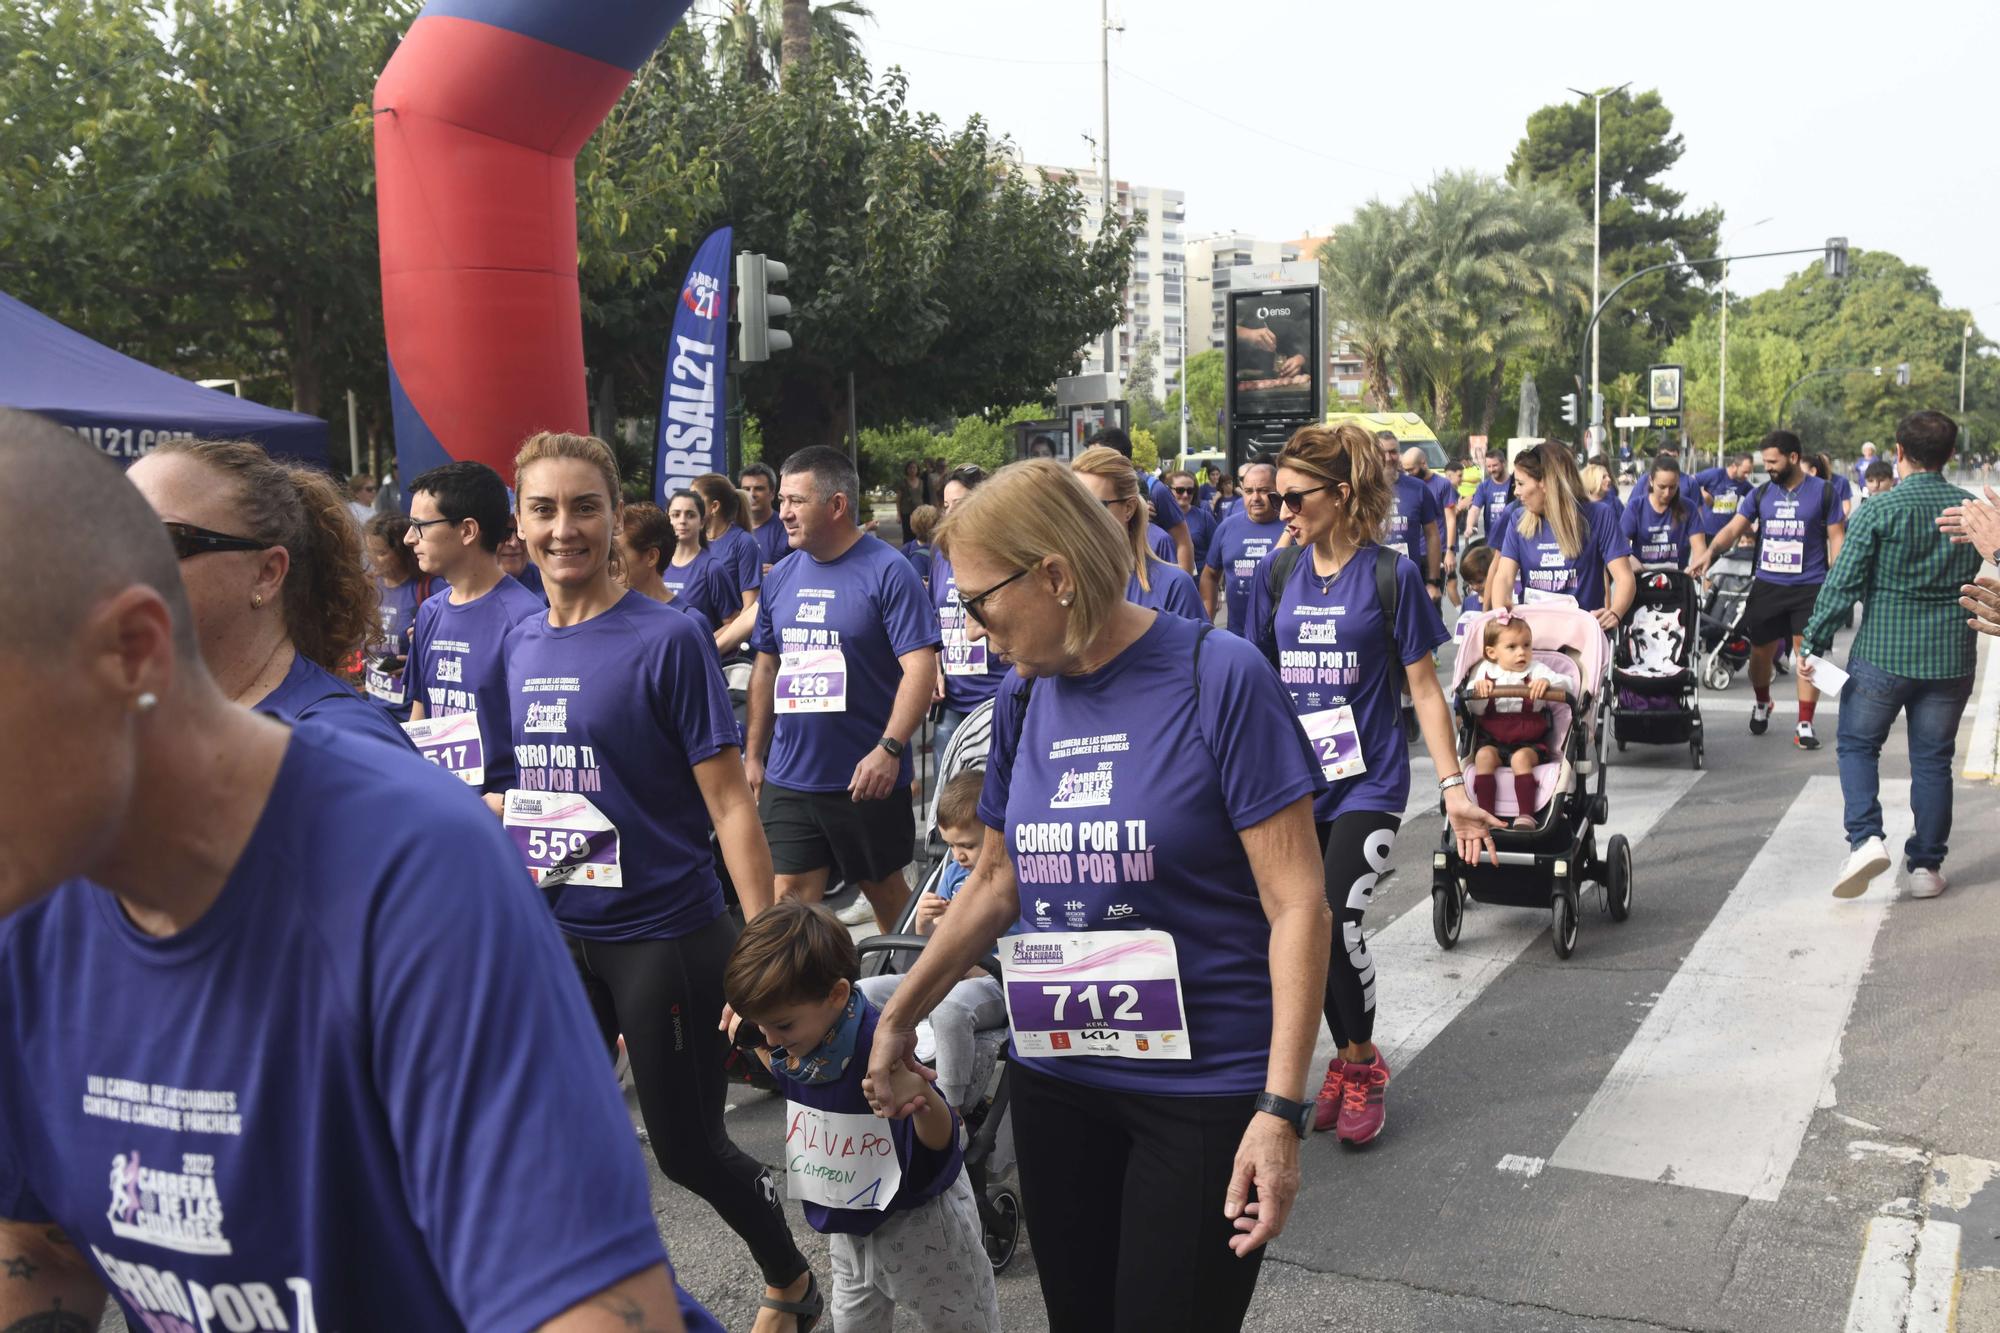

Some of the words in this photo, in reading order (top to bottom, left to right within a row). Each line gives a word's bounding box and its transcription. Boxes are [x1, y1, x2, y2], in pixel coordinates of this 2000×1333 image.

[1768, 552, 1792, 563] 608
[1529, 569, 1553, 580] CORRO
[782, 628, 809, 643] CORRO
[810, 629, 828, 645] POR
[830, 630, 839, 645] TI
[1281, 650, 1317, 668] CORRO
[1319, 651, 1343, 668] POR
[1346, 651, 1357, 668] TI
[370, 672, 392, 690] 694
[1280, 667, 1315, 684] CORRO
[1317, 668, 1340, 685] POR
[788, 677, 829, 696] 428
[447, 690, 466, 708] POR
[539, 705, 566, 713] CARRERA
[546, 712, 554, 720] DE
[555, 712, 567, 720] LAS
[1081, 737, 1089, 746] DE
[1089, 736, 1100, 745] LAS
[580, 746, 596, 769] TI
[1066, 748, 1072, 757] EL
[1092, 744, 1100, 753] DE
[1097, 761, 1113, 770] 2022
[578, 765, 601, 792] MÍ
[1074, 770, 1112, 784] CARRERA
[1082, 781, 1094, 792] DE
[1095, 780, 1113, 791] LAS
[1069, 789, 1110, 801] CIUDADES
[528, 829, 590, 860] 559
[1015, 822, 1073, 853] CORRO
[1079, 820, 1118, 852] POR
[1125, 819, 1146, 850] TI
[1017, 854, 1073, 884] CORRO
[1076, 853, 1117, 883] POR
[1121, 845, 1156, 883] MÍ
[1107, 904, 1133, 916] AEG
[1021, 951, 1033, 959] LAS
[1033, 951, 1063, 959] CIUDADES
[1043, 984, 1143, 1021] 712
[786, 1110, 892, 1158] ALVARO
[182, 1152, 215, 1174] 2022
[789, 1154, 857, 1184] CAMPEON
[138, 1166, 218, 1199] CARRERA
[846, 1177, 882, 1208] 1
[158, 1192, 182, 1217] DE
[185, 1196, 224, 1222] LAS
[136, 1209, 223, 1240] CIUDADES
[186, 1279, 290, 1333] POR
